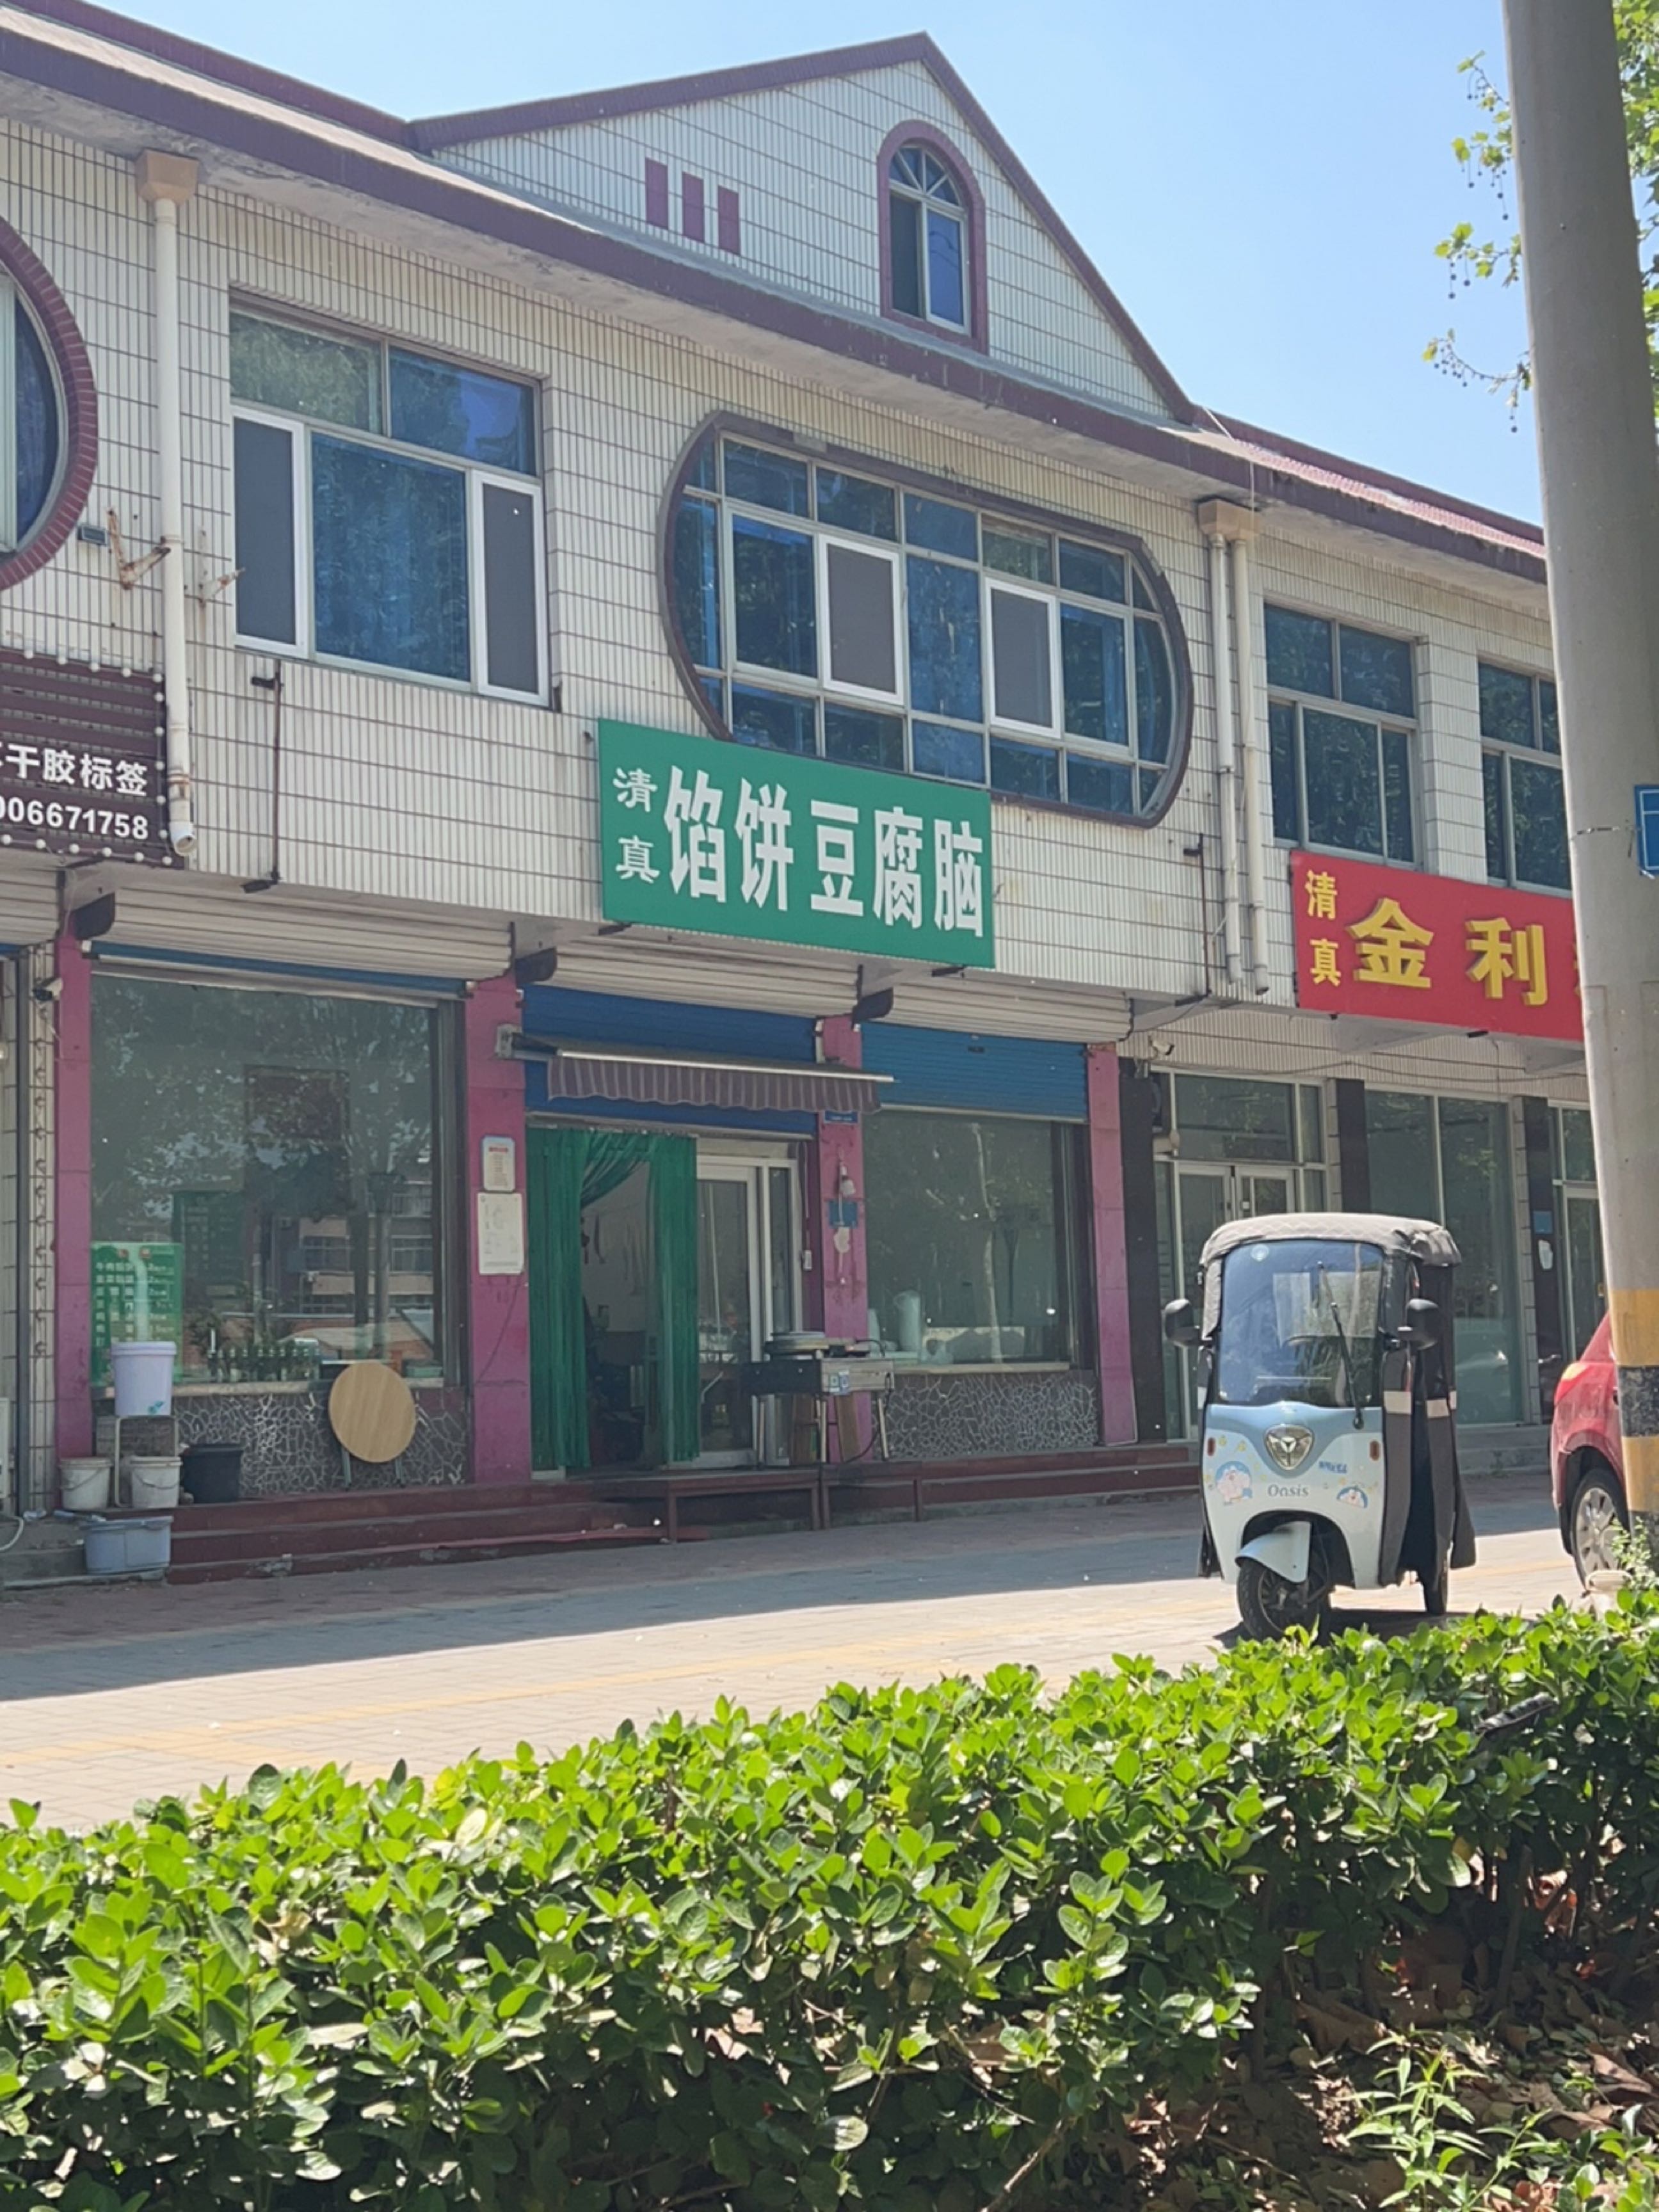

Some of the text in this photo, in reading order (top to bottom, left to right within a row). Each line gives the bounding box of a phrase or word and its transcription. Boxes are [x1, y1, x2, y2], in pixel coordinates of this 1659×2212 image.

[0, 741, 148, 797] 干胶标签
[613, 767, 660, 884] 清真
[663, 765, 983, 938] 馅饼豆腐脑
[1304, 869, 1342, 987] 清真
[1346, 897, 1582, 1007] 金利
[1267, 1484, 1310, 1498] Oasis
